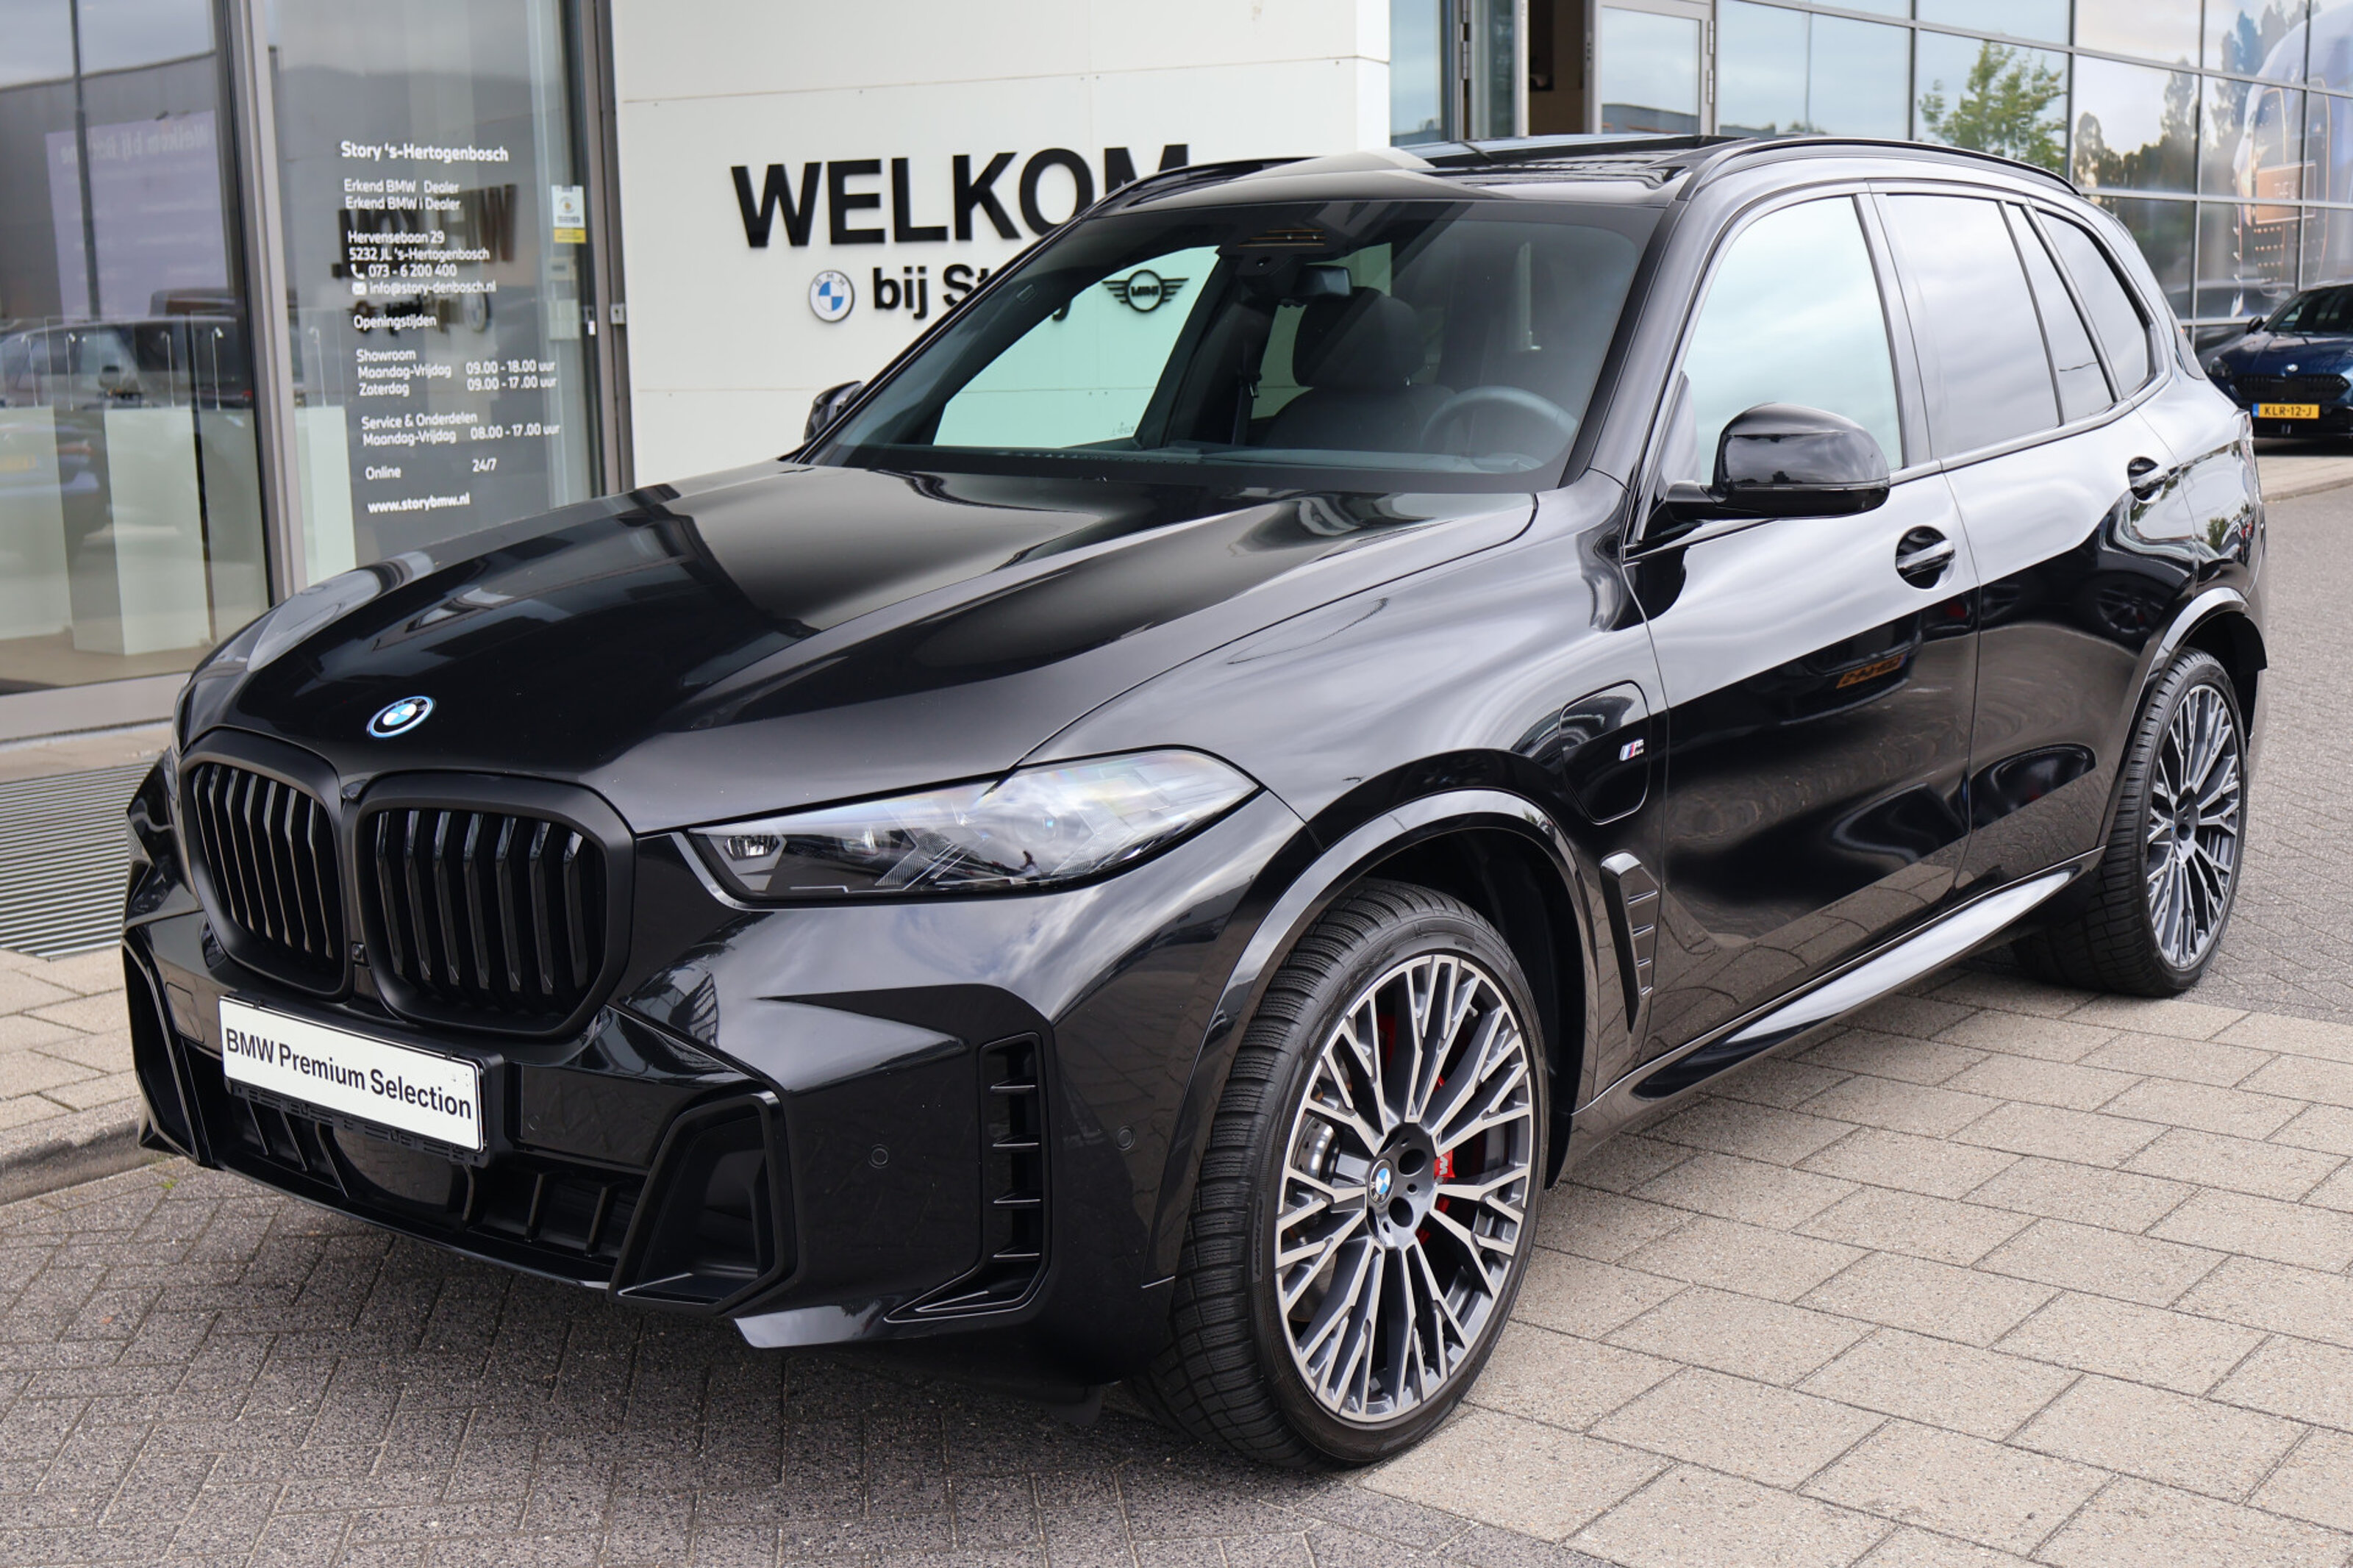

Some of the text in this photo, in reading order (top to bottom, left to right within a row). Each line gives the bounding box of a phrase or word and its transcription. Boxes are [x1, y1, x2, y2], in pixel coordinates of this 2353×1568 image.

[340, 140, 509, 162] Story 's-Hertogenbosch
[343, 179, 460, 194] Erkend BMW Dealer
[346, 196, 385, 210] Erkend
[388, 197, 417, 210] BMW
[425, 197, 461, 210] Dealer
[348, 230, 445, 244] Hervensebaan 29
[349, 248, 490, 262] 5232 JL 's-Hertogenbosch
[368, 265, 389, 278] 073
[401, 265, 408, 277] 6
[410, 265, 432, 277] 200
[434, 264, 457, 277] 400
[369, 280, 497, 297] info@story-denbosch.nl
[873, 266, 928, 320] bij
[353, 315, 437, 330] Openingstijden
[357, 348, 416, 362] Showroom
[358, 364, 452, 380] Maandag-Vrijdag
[538, 361, 556, 372] uur
[359, 382, 410, 397] Zaterdag
[539, 377, 557, 388] uur
[2265, 406, 2313, 416] KLR-12-J
[361, 412, 478, 430] Service & Onderdelen
[363, 429, 457, 446] Maandag-Vrijdag
[543, 424, 560, 436] uur
[365, 458, 497, 480] Online 24/7
[368, 492, 470, 513] www.storybmw.nl
[226, 1028, 472, 1120] BMW Premium Selection
